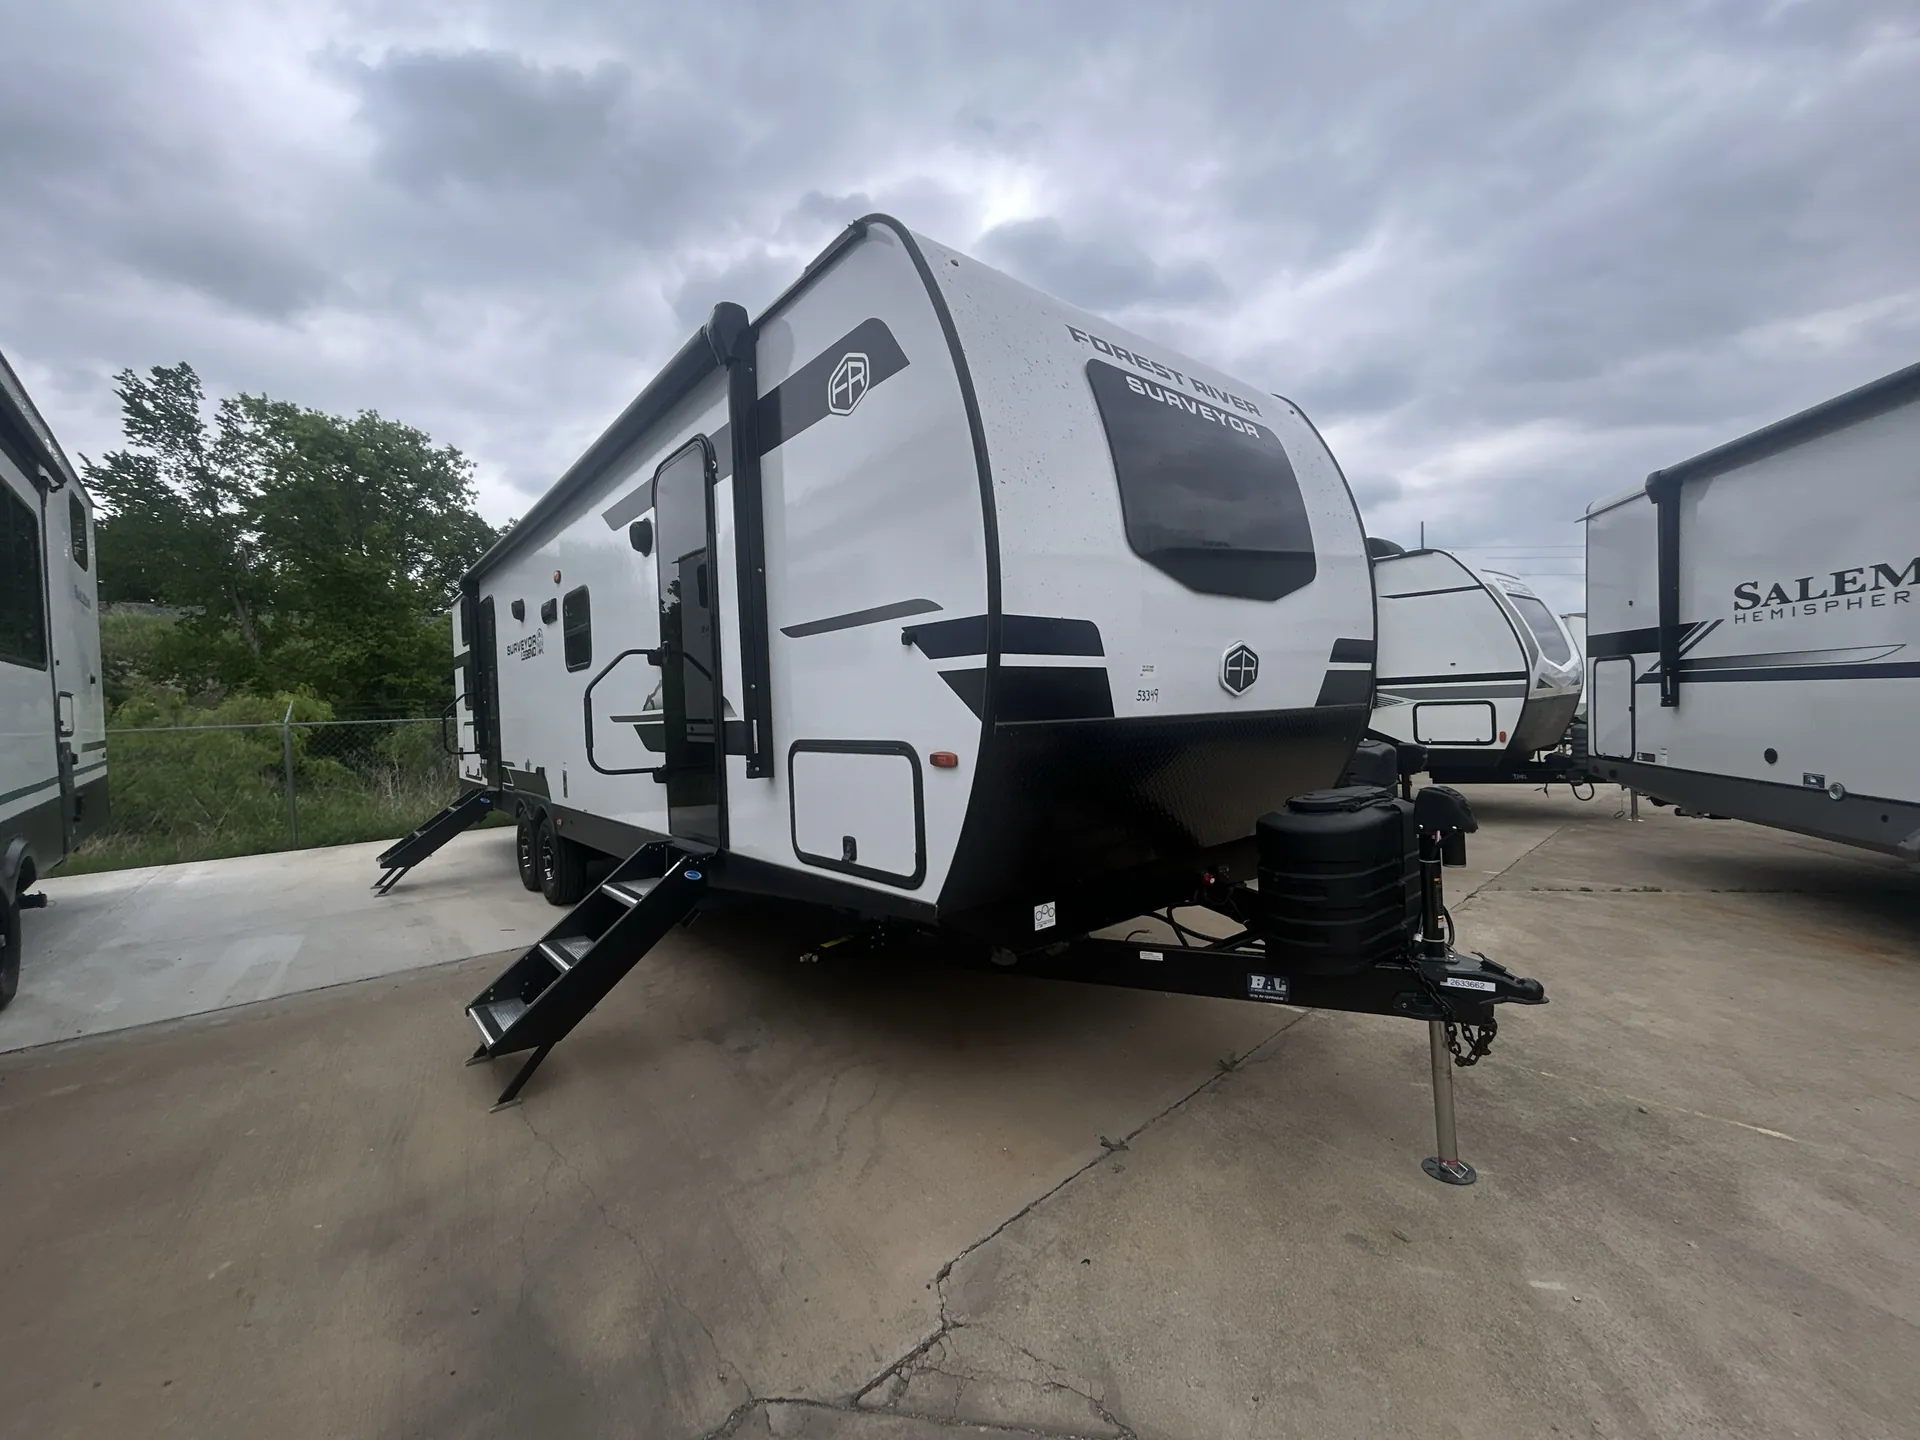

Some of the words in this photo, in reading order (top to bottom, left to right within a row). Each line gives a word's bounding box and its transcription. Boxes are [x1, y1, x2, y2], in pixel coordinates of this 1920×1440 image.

[1064, 323, 1184, 386] FOREST
[1187, 376, 1263, 418] RIVER
[1125, 375, 1260, 439] SURVEYOR
[1733, 556, 1920, 611] SALEM
[506, 634, 537, 656] SURVEYOR
[1250, 975, 1287, 992] BAL
[1450, 979, 1485, 990] 2633662
